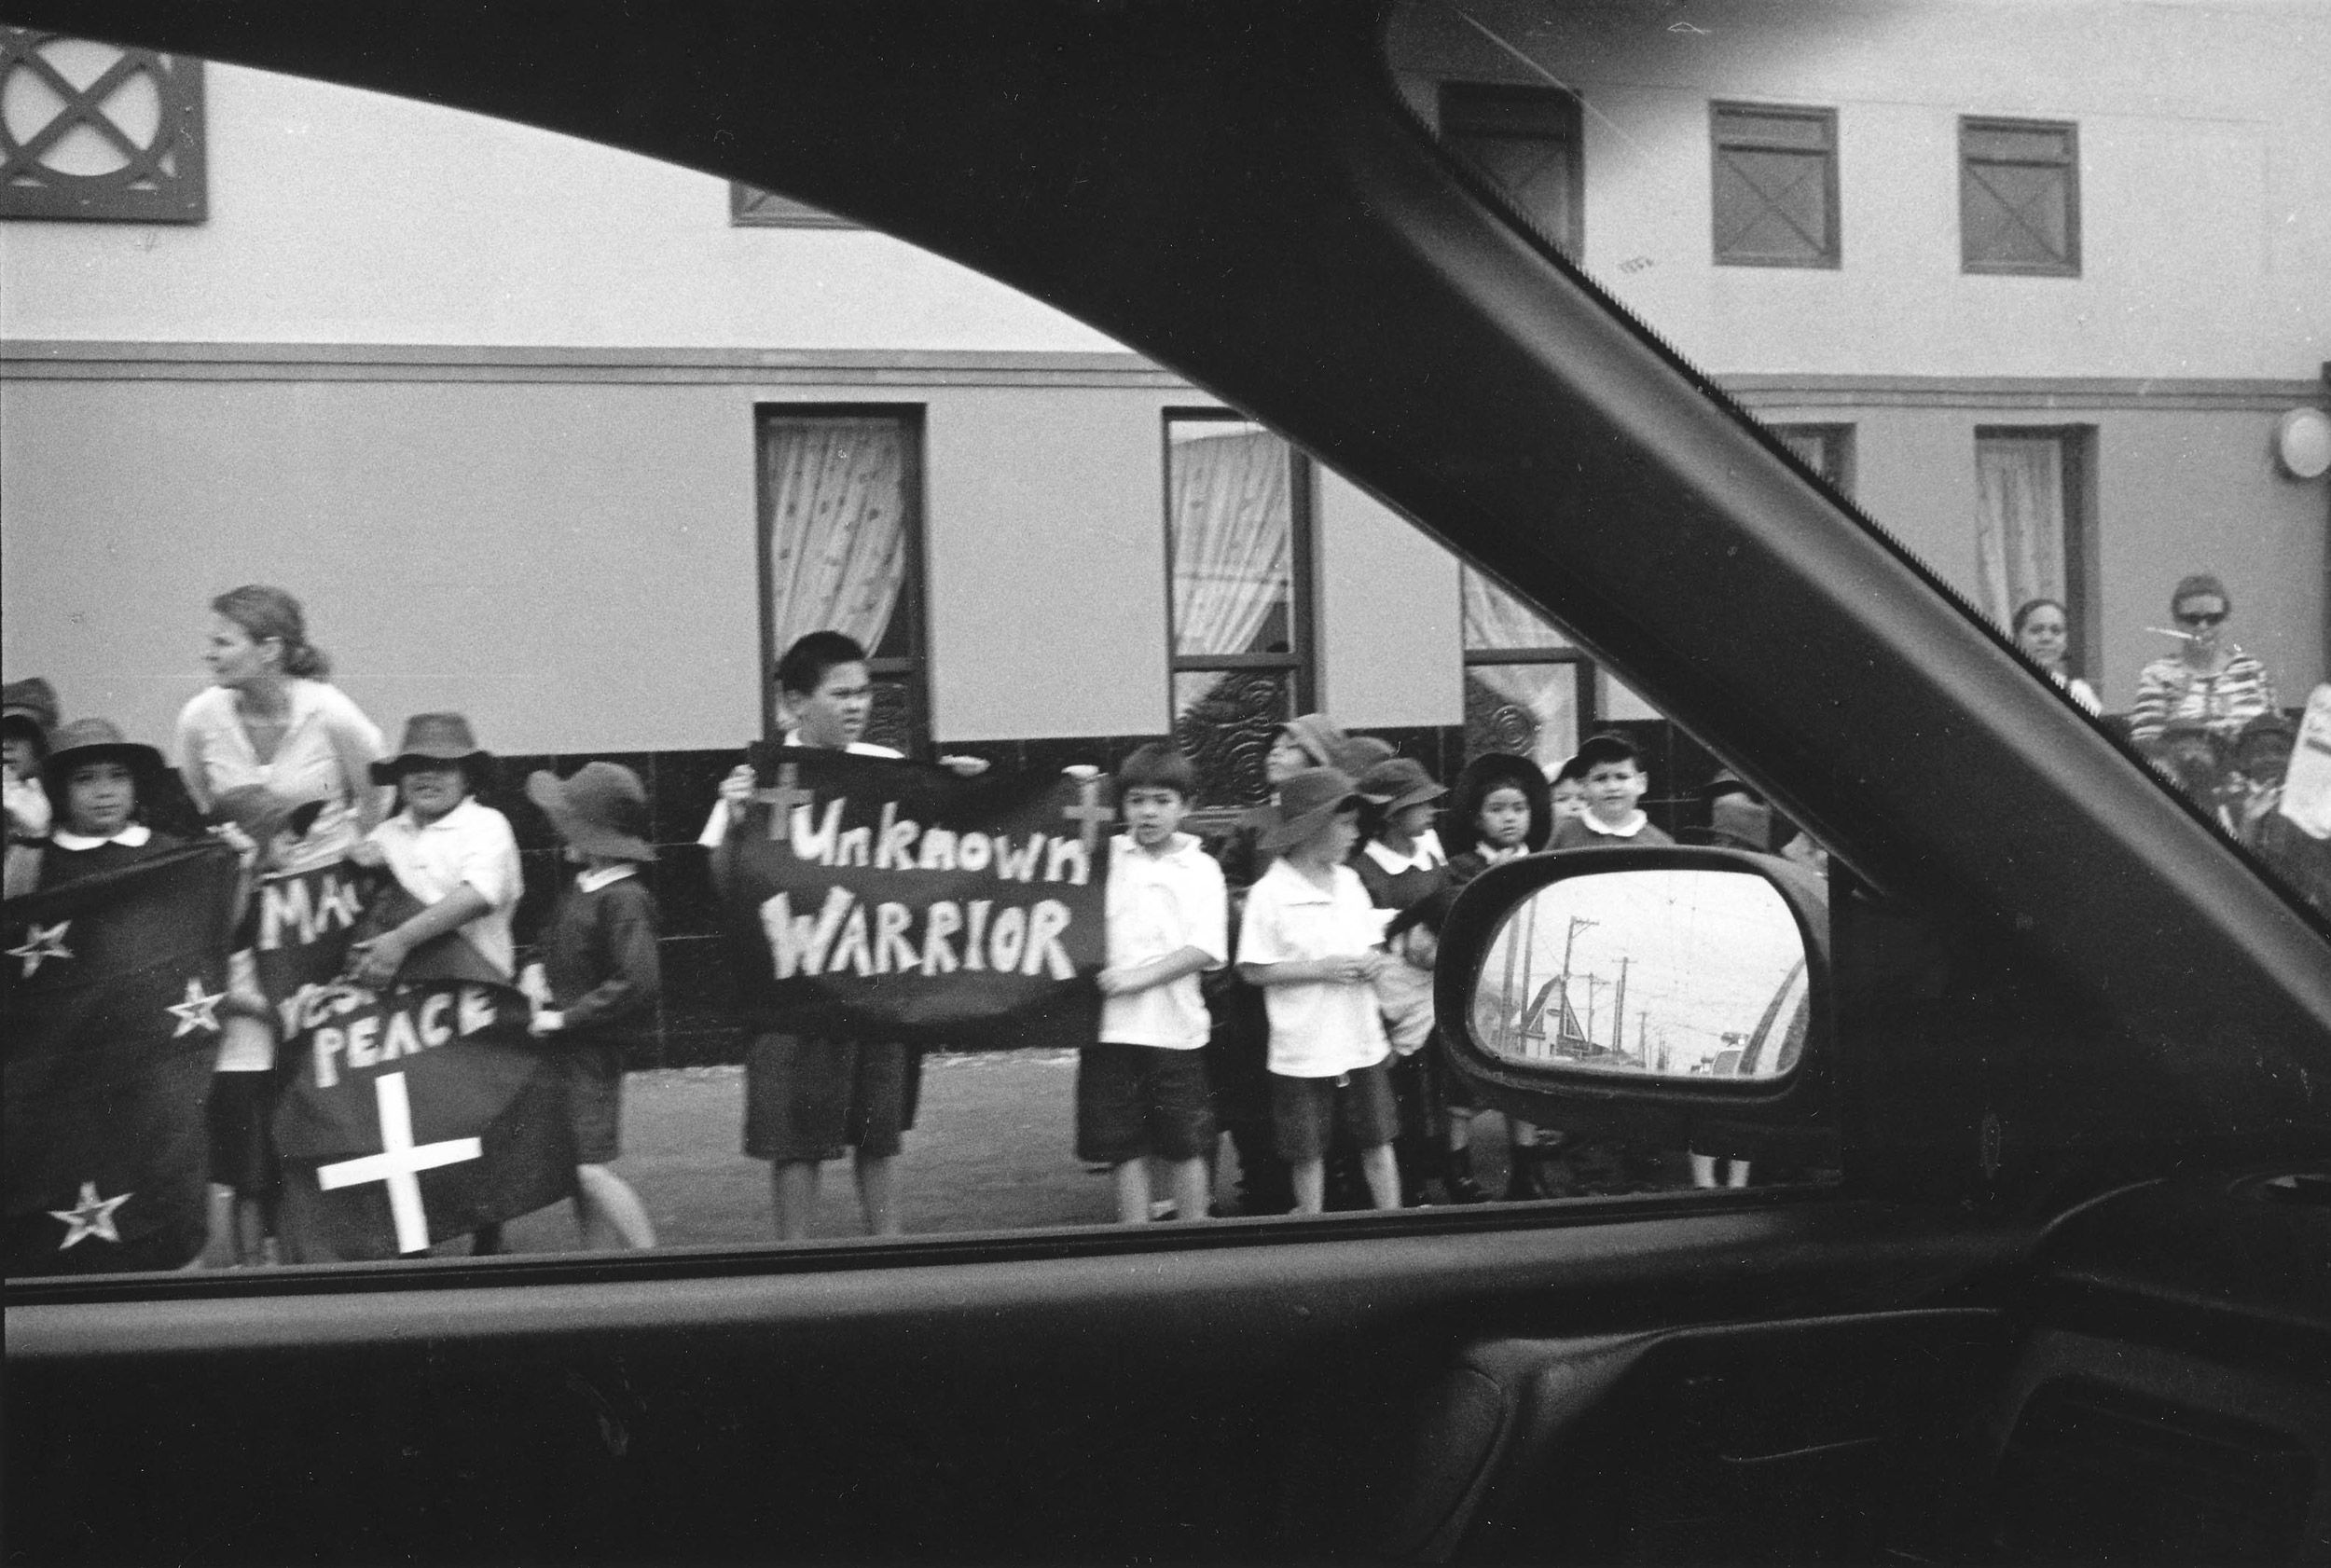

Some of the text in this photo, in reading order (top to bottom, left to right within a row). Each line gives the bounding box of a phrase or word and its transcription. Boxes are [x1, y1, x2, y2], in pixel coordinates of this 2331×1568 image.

[790, 797, 1093, 885] Unknown
[759, 886, 1077, 980] WARRIOR
[312, 986, 499, 1089] PEACE
